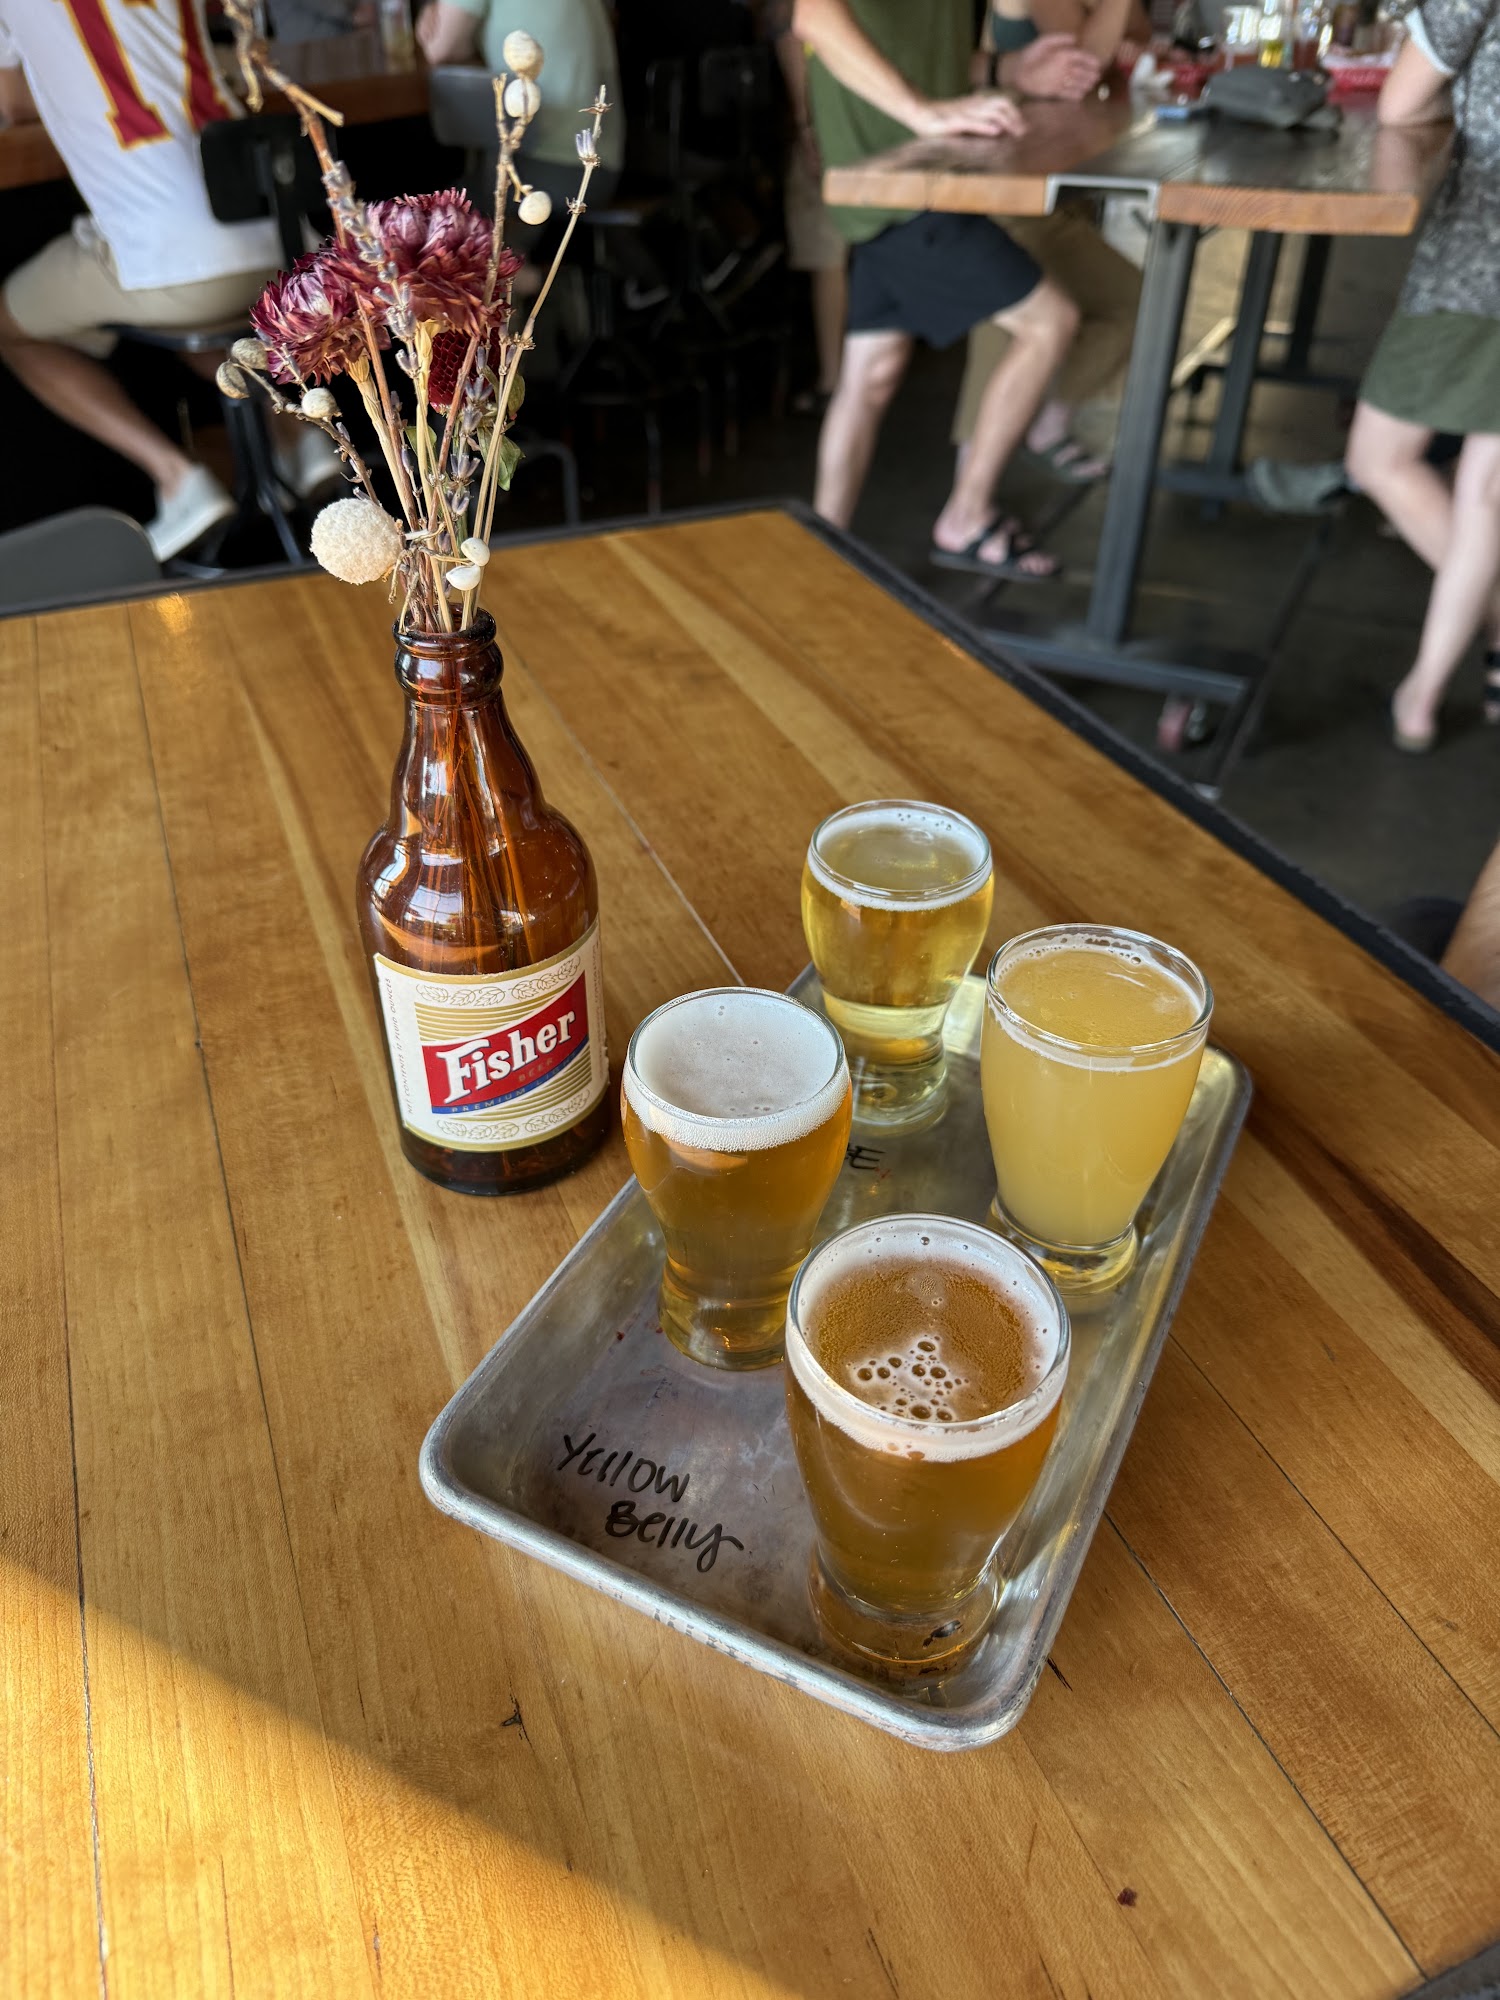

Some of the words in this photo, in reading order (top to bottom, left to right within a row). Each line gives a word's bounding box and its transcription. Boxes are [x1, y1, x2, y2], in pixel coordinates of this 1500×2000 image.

[385, 977, 396, 1014] OUNCES
[392, 1016, 400, 1041] FLUID
[399, 1053, 410, 1097] CONTENTS
[436, 1010, 576, 1104] Fisher
[518, 1057, 553, 1083] BEER
[451, 1088, 526, 1113] PREMIUM
[604, 1500, 745, 1573] Belly
